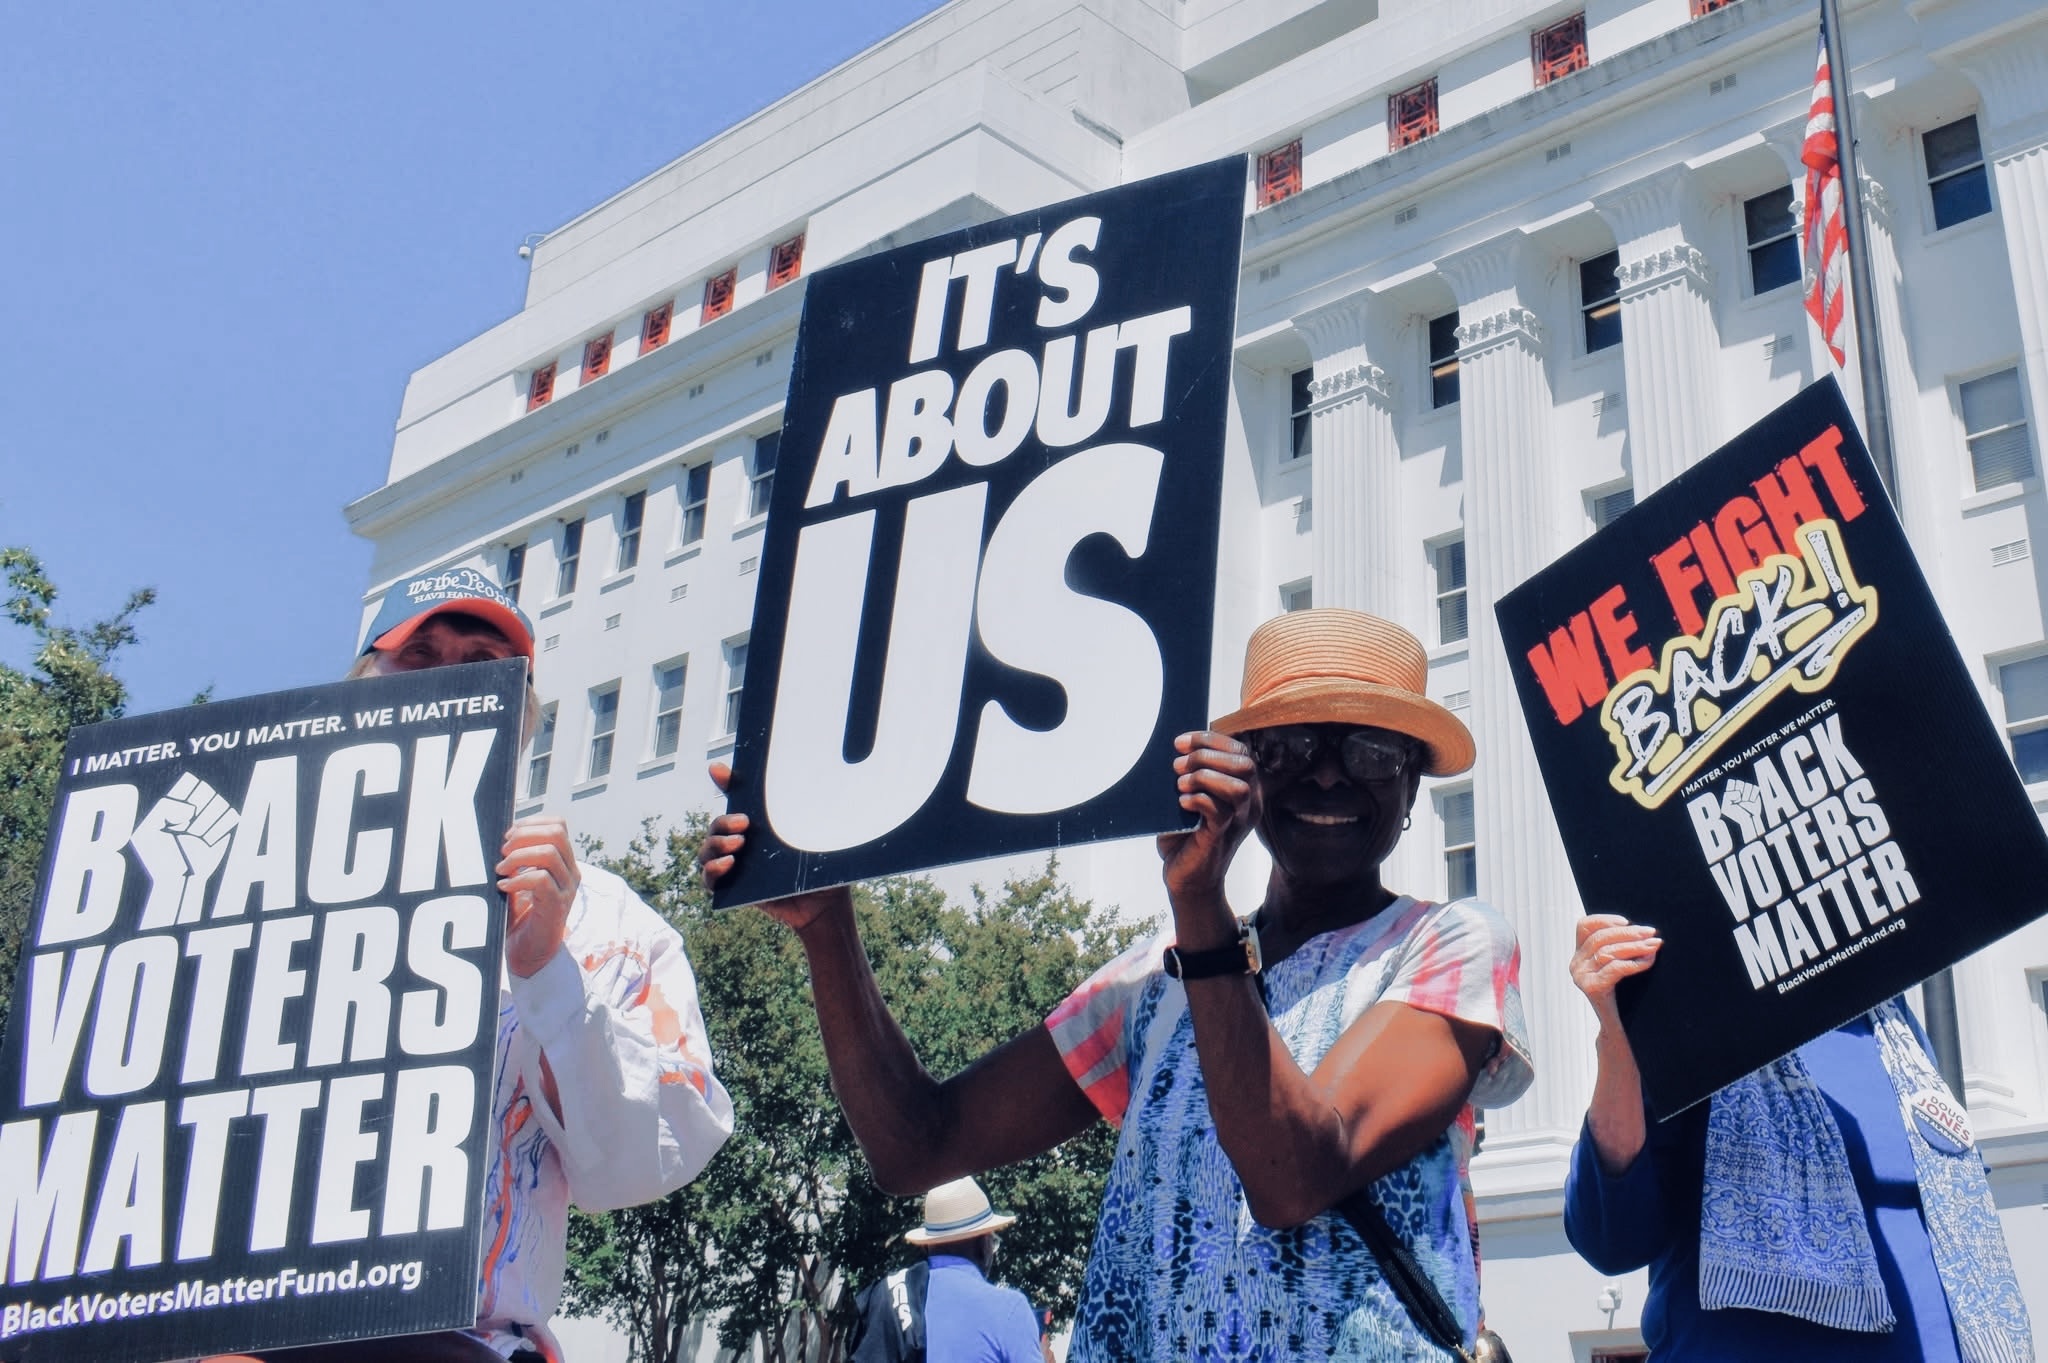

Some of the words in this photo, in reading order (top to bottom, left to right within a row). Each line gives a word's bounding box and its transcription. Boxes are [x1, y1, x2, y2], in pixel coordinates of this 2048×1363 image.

[908, 217, 1102, 365] IT'S
[804, 305, 1191, 508] ABOUT
[414, 591, 446, 603] HAVE
[765, 442, 1165, 853] US
[1527, 584, 1655, 726] WE
[1650, 425, 1867, 636] FIGHT
[1612, 529, 1848, 779] BACK!
[71, 758, 81, 775] I
[85, 741, 181, 773] MATTER.
[189, 730, 240, 754] YOU
[246, 714, 346, 745] MATTER.
[354, 707, 394, 729] WE
[401, 694, 505, 723] MATTER.
[1686, 767, 1723, 794] MATTER.
[1721, 756, 1742, 771] YOU
[1743, 732, 1781, 760] MATTER.
[1779, 720, 1796, 735] WE
[1796, 698, 1836, 725] MATTER.
[1687, 713, 1865, 865] BACK
[37, 728, 497, 947] BACK
[1709, 777, 1890, 923] VOTERS
[1732, 840, 1921, 990] MATTER
[1777, 918, 1906, 995] BlackVotersMatterFund.org
[22, 895, 489, 1108] VOTERS
[0, 1065, 475, 1287] MATTER
[1917, 1098, 1970, 1141] JONES
[1930, 1096, 1965, 1124] DOUG
[2, 1260, 423, 1338] BlackVotersMatterFund.org
